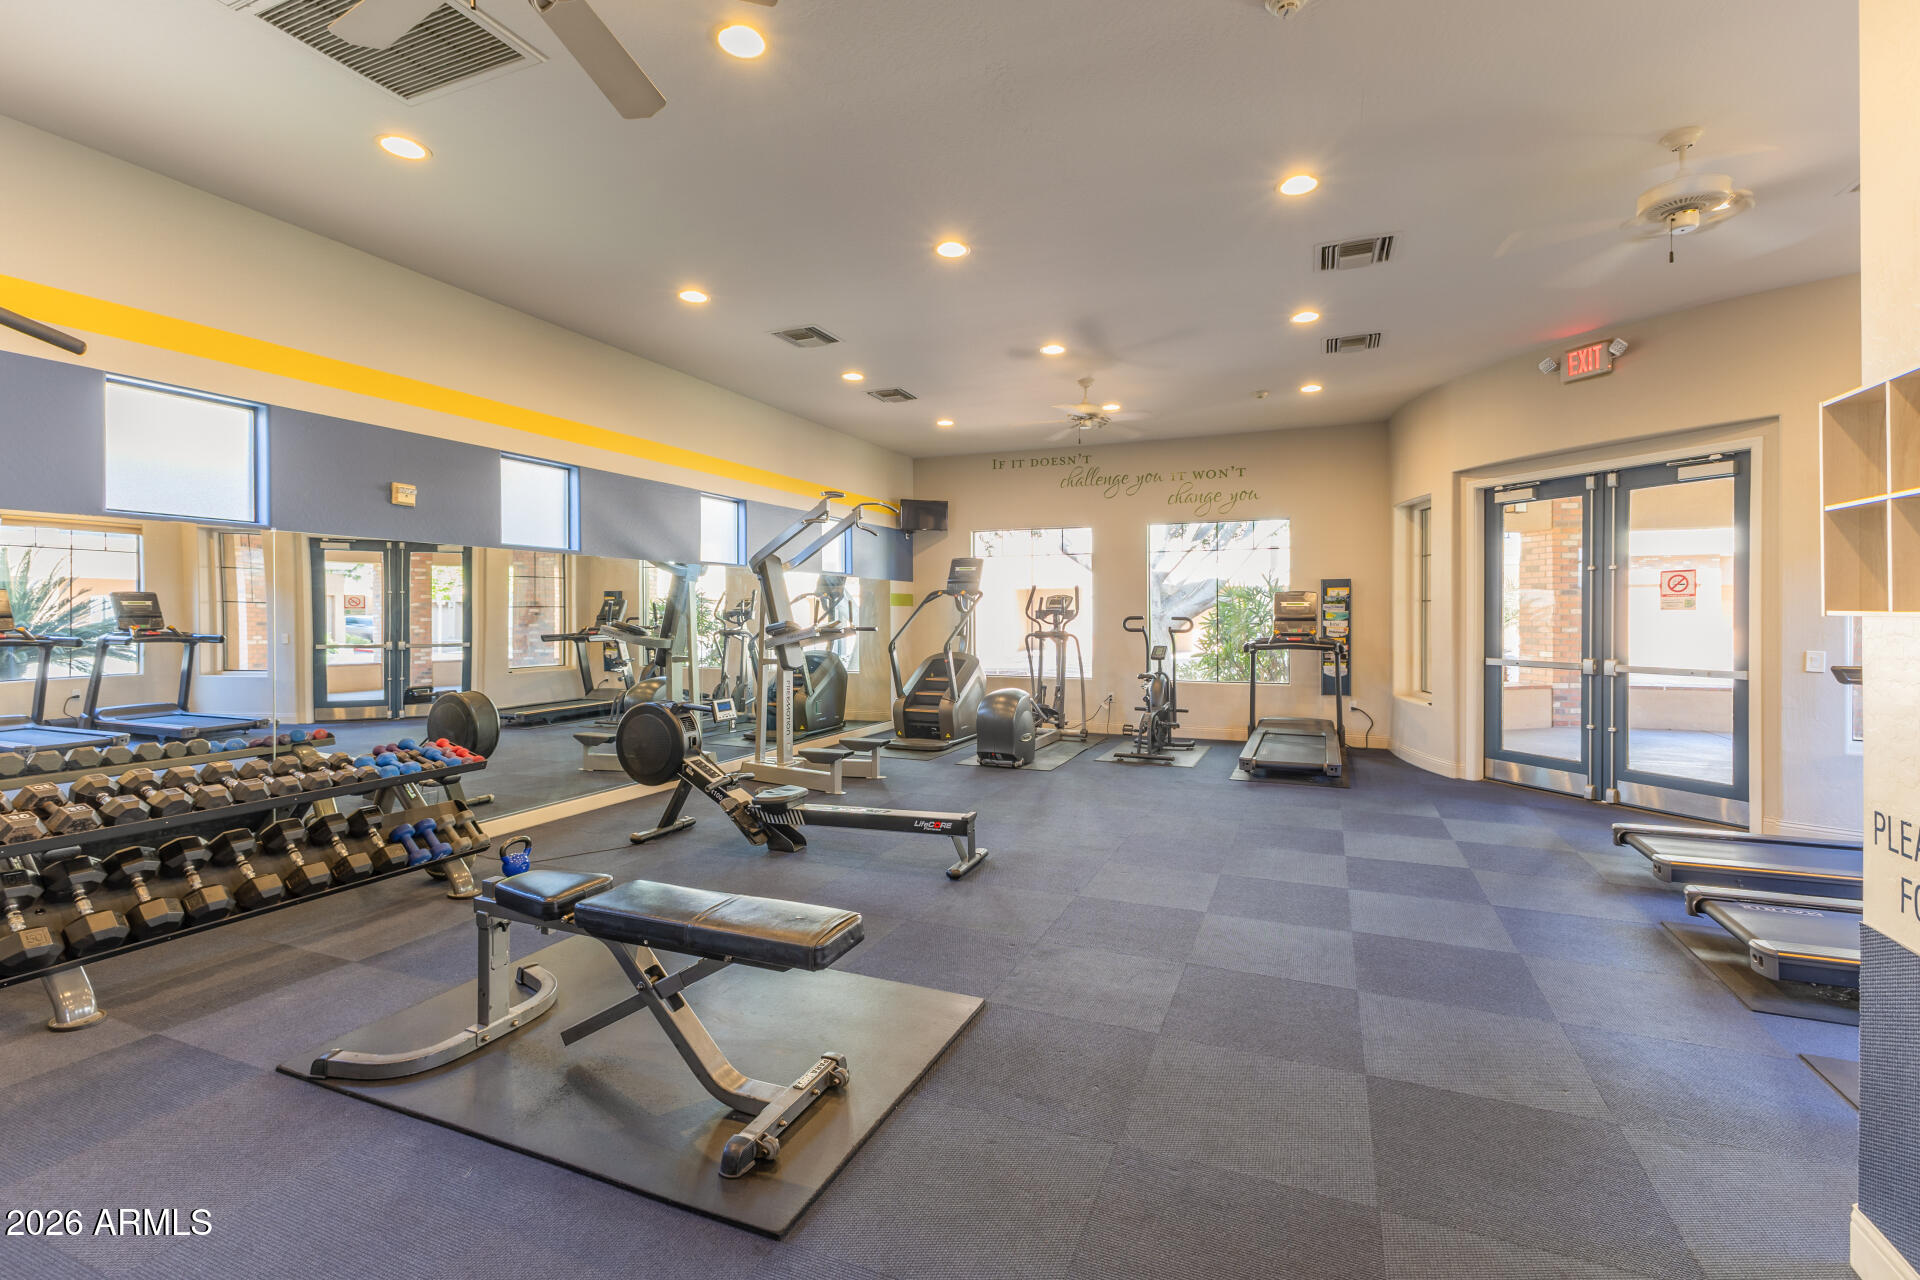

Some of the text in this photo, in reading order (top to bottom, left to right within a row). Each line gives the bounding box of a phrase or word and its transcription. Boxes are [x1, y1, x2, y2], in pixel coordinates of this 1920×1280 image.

[1568, 344, 1602, 376] EXIT
[1011, 459, 1024, 469] IT
[1030, 453, 1092, 468] DOESN'T
[1060, 465, 1247, 499] challenge you IT WON'T
[1167, 481, 1259, 518] change you
